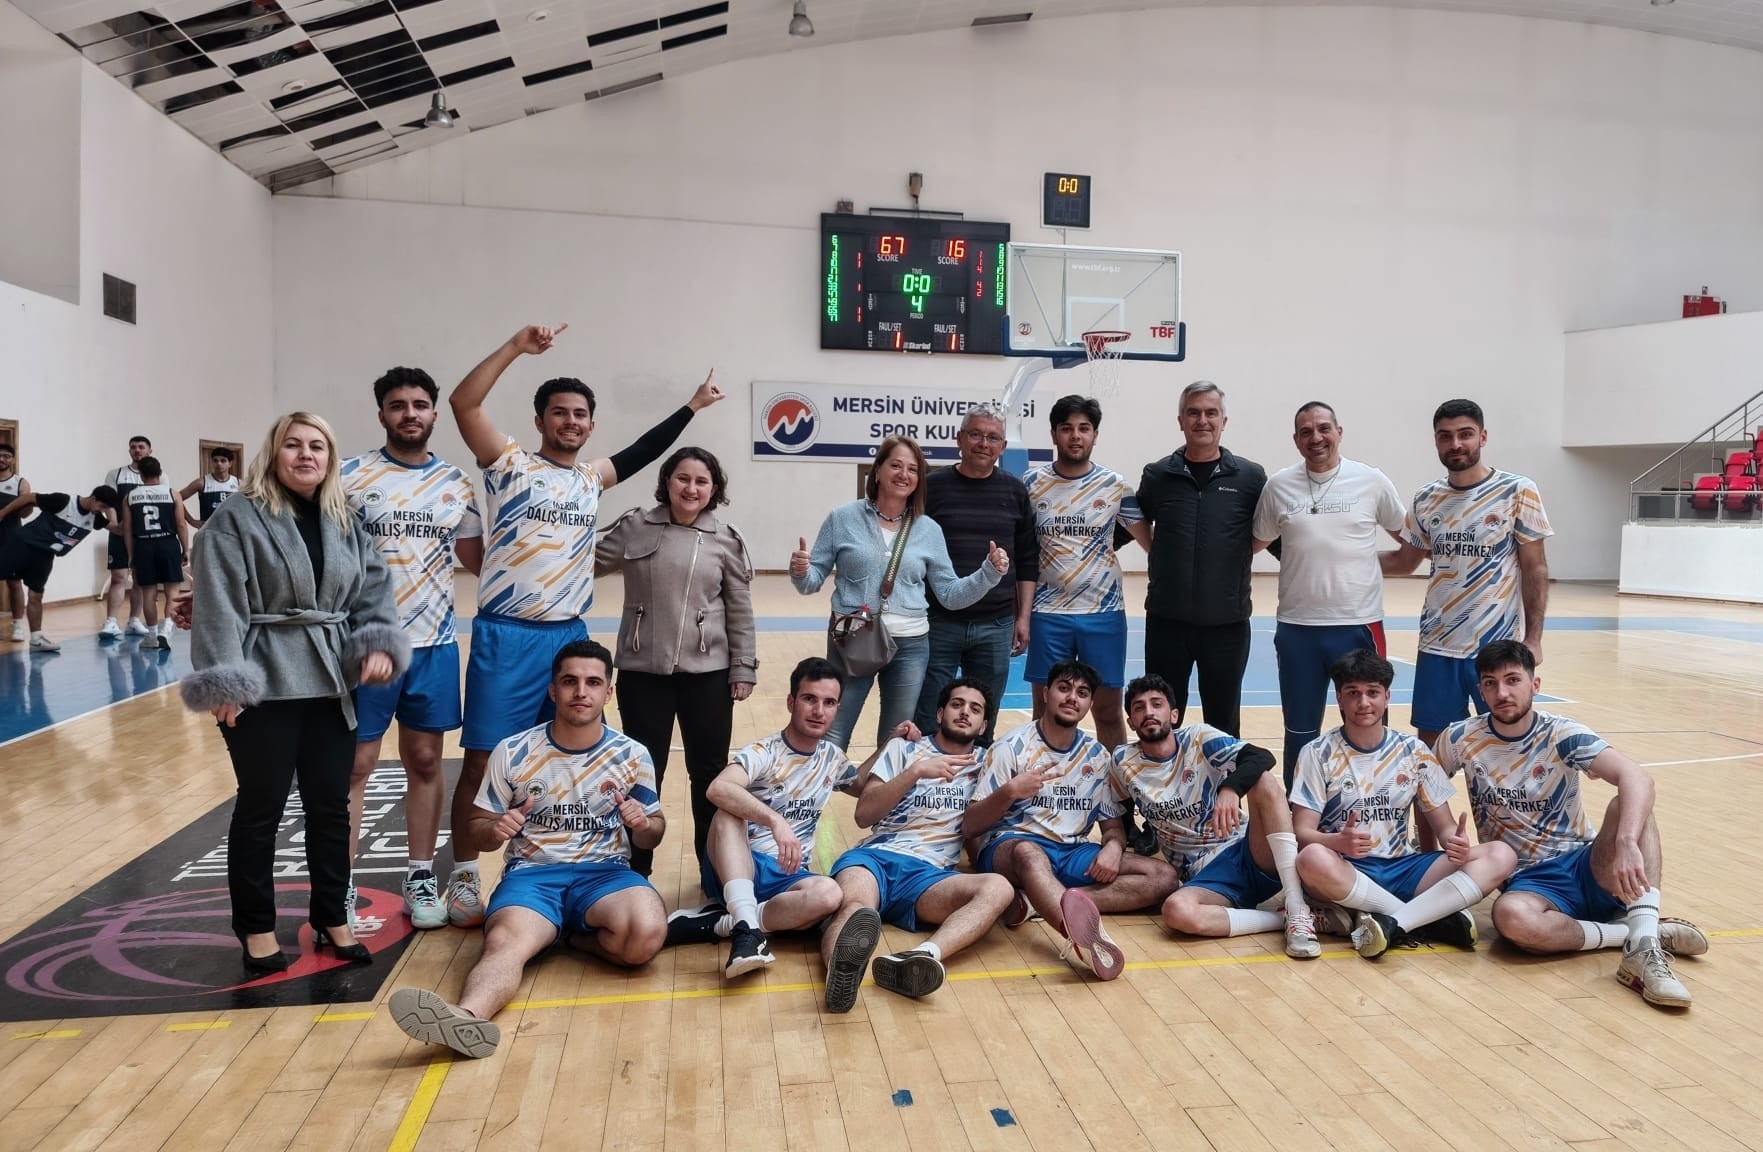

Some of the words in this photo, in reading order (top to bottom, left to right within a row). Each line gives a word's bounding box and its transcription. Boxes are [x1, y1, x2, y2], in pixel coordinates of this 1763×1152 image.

[1059, 177, 1078, 193] 0:0
[880, 236, 905, 254] 67
[948, 240, 965, 257] 16
[877, 253, 899, 262] SCORE
[937, 256, 960, 265] SCORE
[903, 274, 931, 293] 0:0
[976, 289, 982, 297] 2
[911, 295, 922, 312] 4
[895, 331, 901, 348] 1
[1150, 326, 1175, 339] TBF
[951, 334, 956, 350] 1
[833, 396, 905, 414] MERSİN
[869, 423, 919, 439] SPOR
[925, 425, 961, 440] KUL
[142, 505, 162, 531] 2
[393, 510, 434, 523] MERSİN
[526, 505, 557, 526] DALIŞ
[1054, 514, 1086, 525] MERSİN
[366, 523, 401, 540] DALIŞ
[1445, 532, 1476, 543] MERSİN
[935, 785, 964, 797] MERSİN
[914, 795, 942, 811] DALIŞ
[944, 797, 969, 812] MERK
